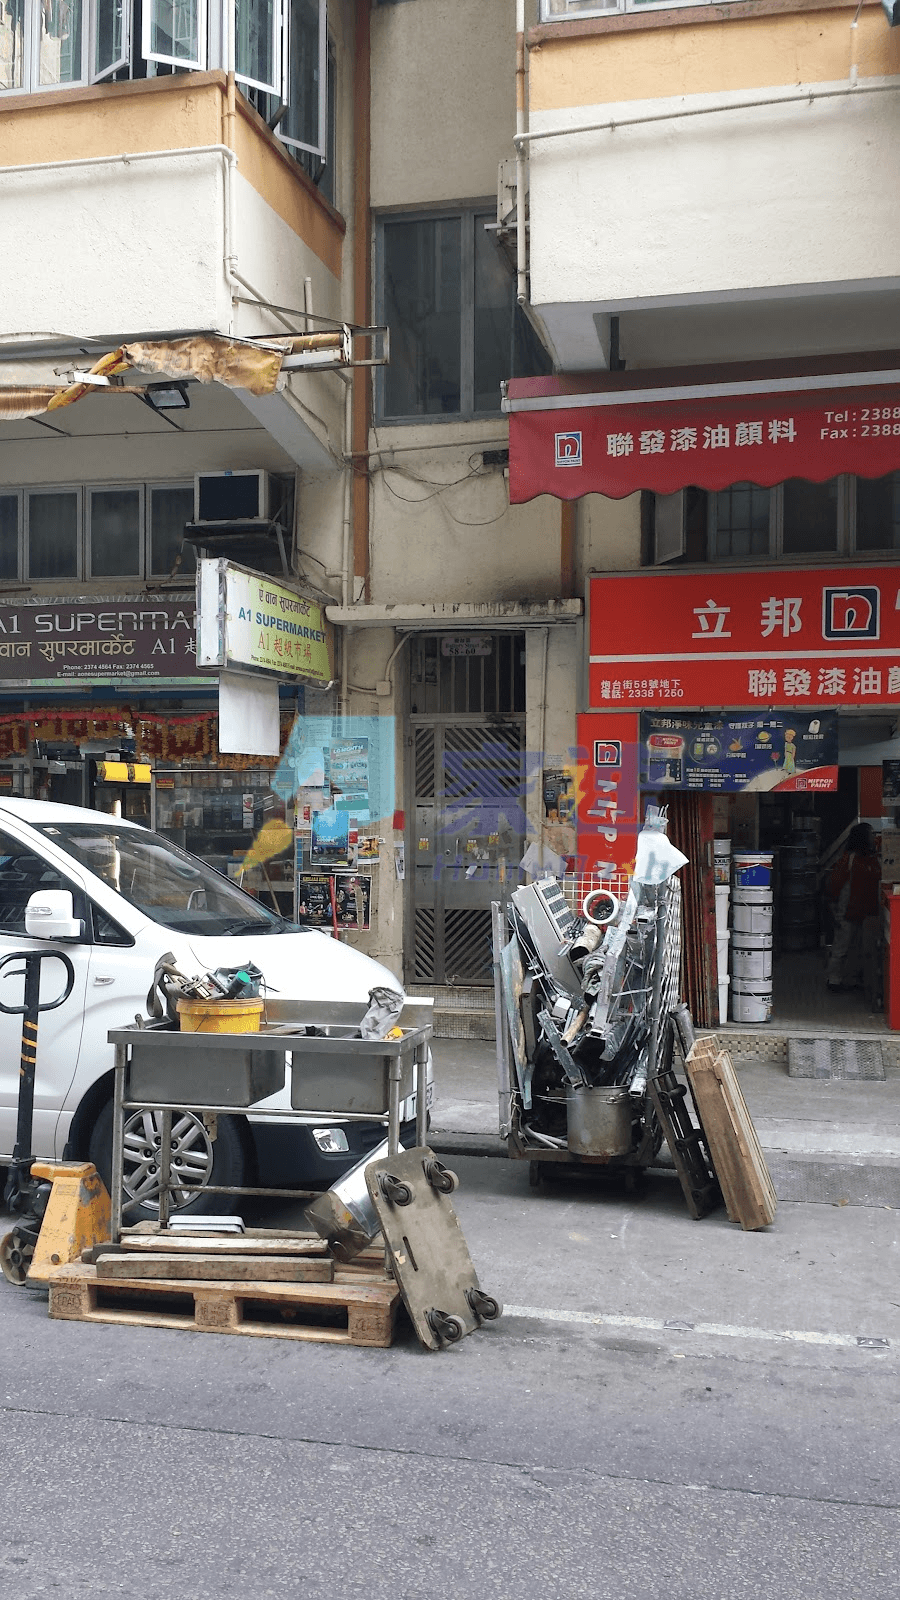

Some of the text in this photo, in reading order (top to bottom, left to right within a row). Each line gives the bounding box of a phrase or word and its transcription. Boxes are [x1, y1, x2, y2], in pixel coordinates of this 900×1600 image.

[606, 418, 798, 458] 聯發漆油顏料
[34, 611, 197, 634] SUPERMA
[238, 607, 327, 643] A1 SUPERMARKET
[38, 634, 137, 662] सुपरमार्केट
[151, 638, 176, 655] A1
[257, 631, 313, 664] A1 超級市場
[465, 647, 476, 655] 60
